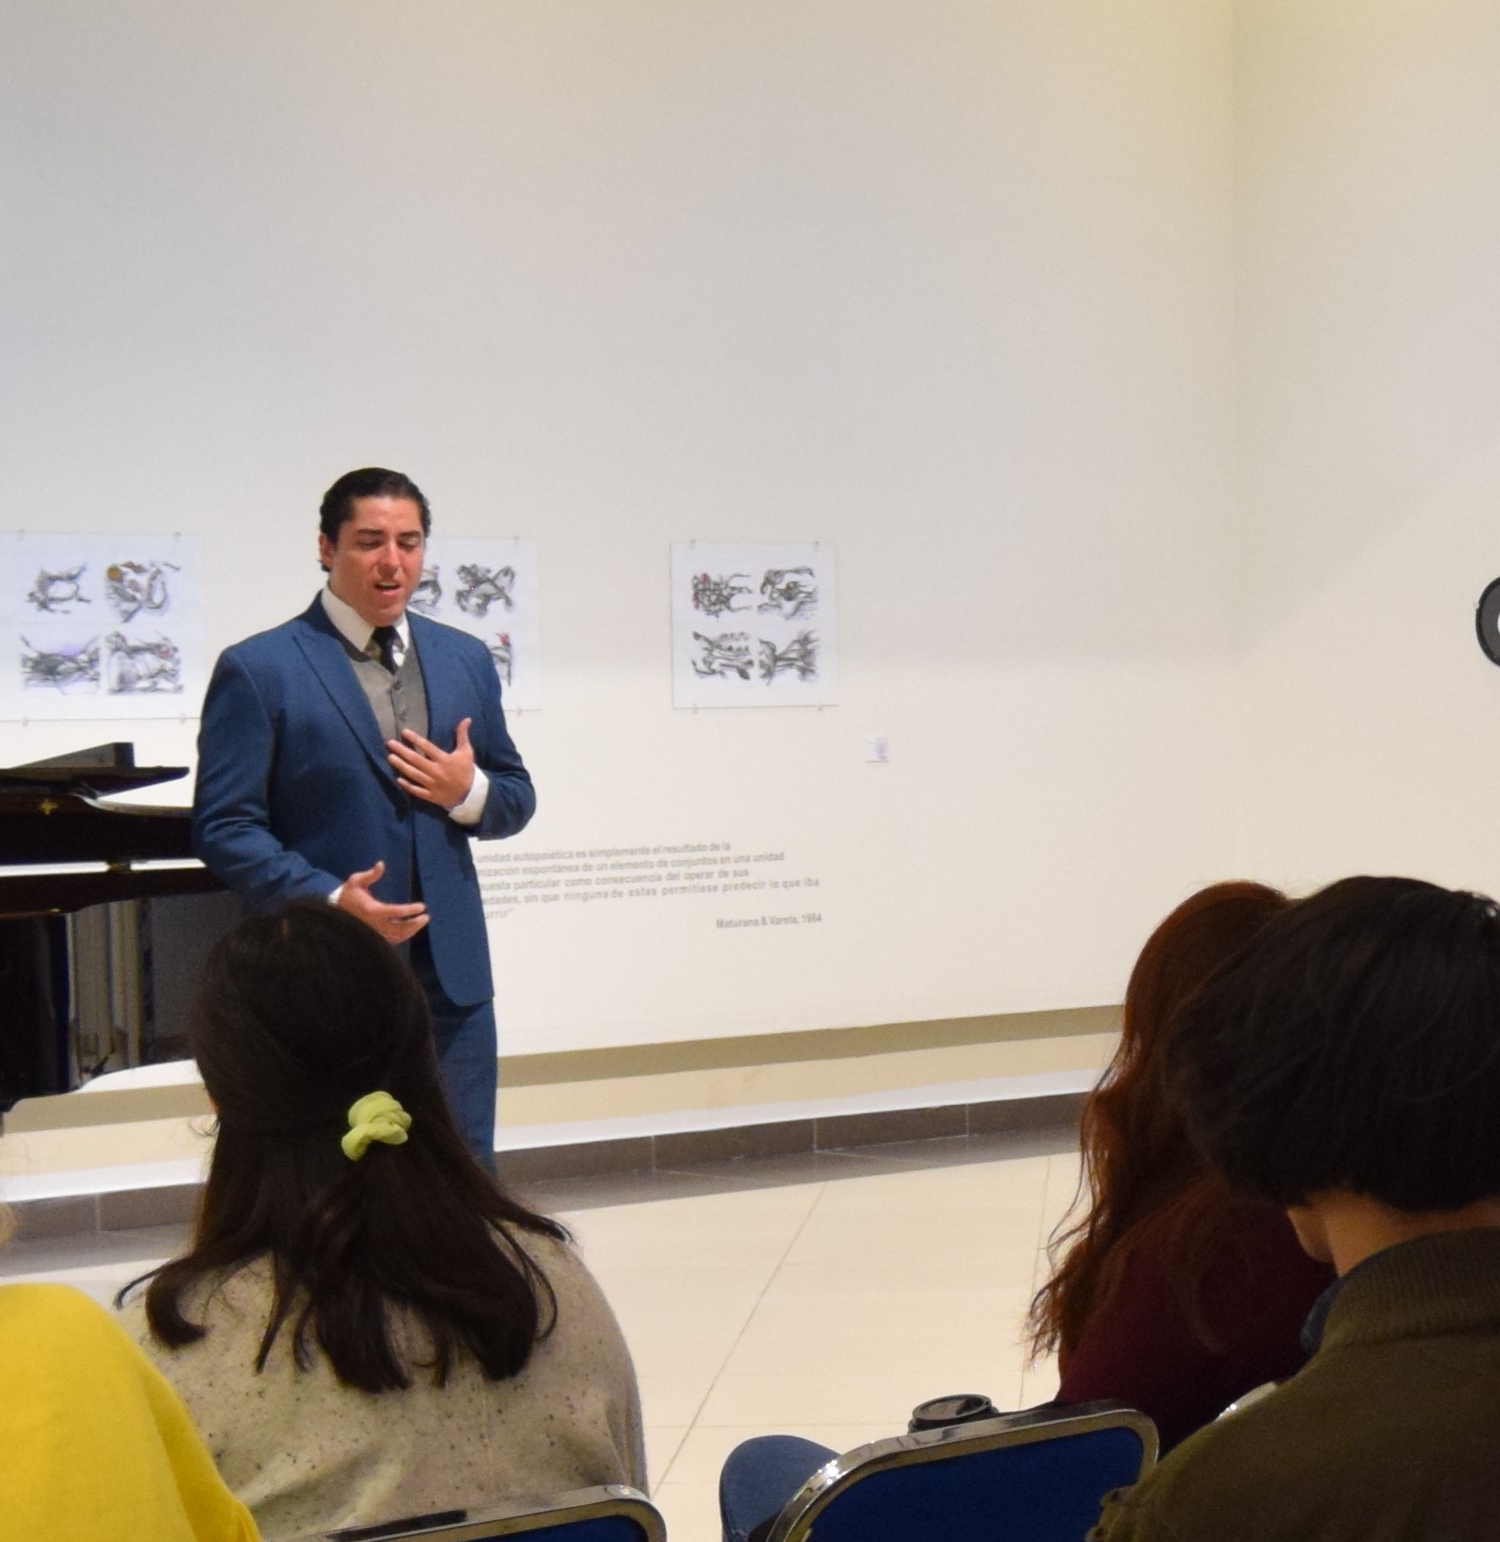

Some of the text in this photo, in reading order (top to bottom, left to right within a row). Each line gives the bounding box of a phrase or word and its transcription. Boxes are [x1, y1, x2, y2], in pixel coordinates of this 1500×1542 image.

[476, 853, 511, 863] unidad
[575, 850, 586, 858] es
[652, 845, 661, 854] el
[663, 842, 707, 853] resultado
[709, 842, 720, 851] de
[722, 841, 731, 851] la
[477, 866, 520, 877] nización
[582, 862, 594, 872] de
[596, 863, 608, 871] un
[610, 860, 654, 870] elemento
[656, 858, 668, 867] de
[671, 856, 718, 868] conjuntos
[719, 856, 731, 864] en
[733, 855, 750, 863] una
[753, 852, 785, 862] unidad
[480, 869, 749, 891] uesta particular como consecuencia del operar de sus
[482, 876, 820, 905] edades, sin que ninguna de estas permitiese predecir lo que iba
[716, 917, 759, 929] Maturana
[761, 915, 768, 926] &
[768, 914, 798, 925] Varela,
